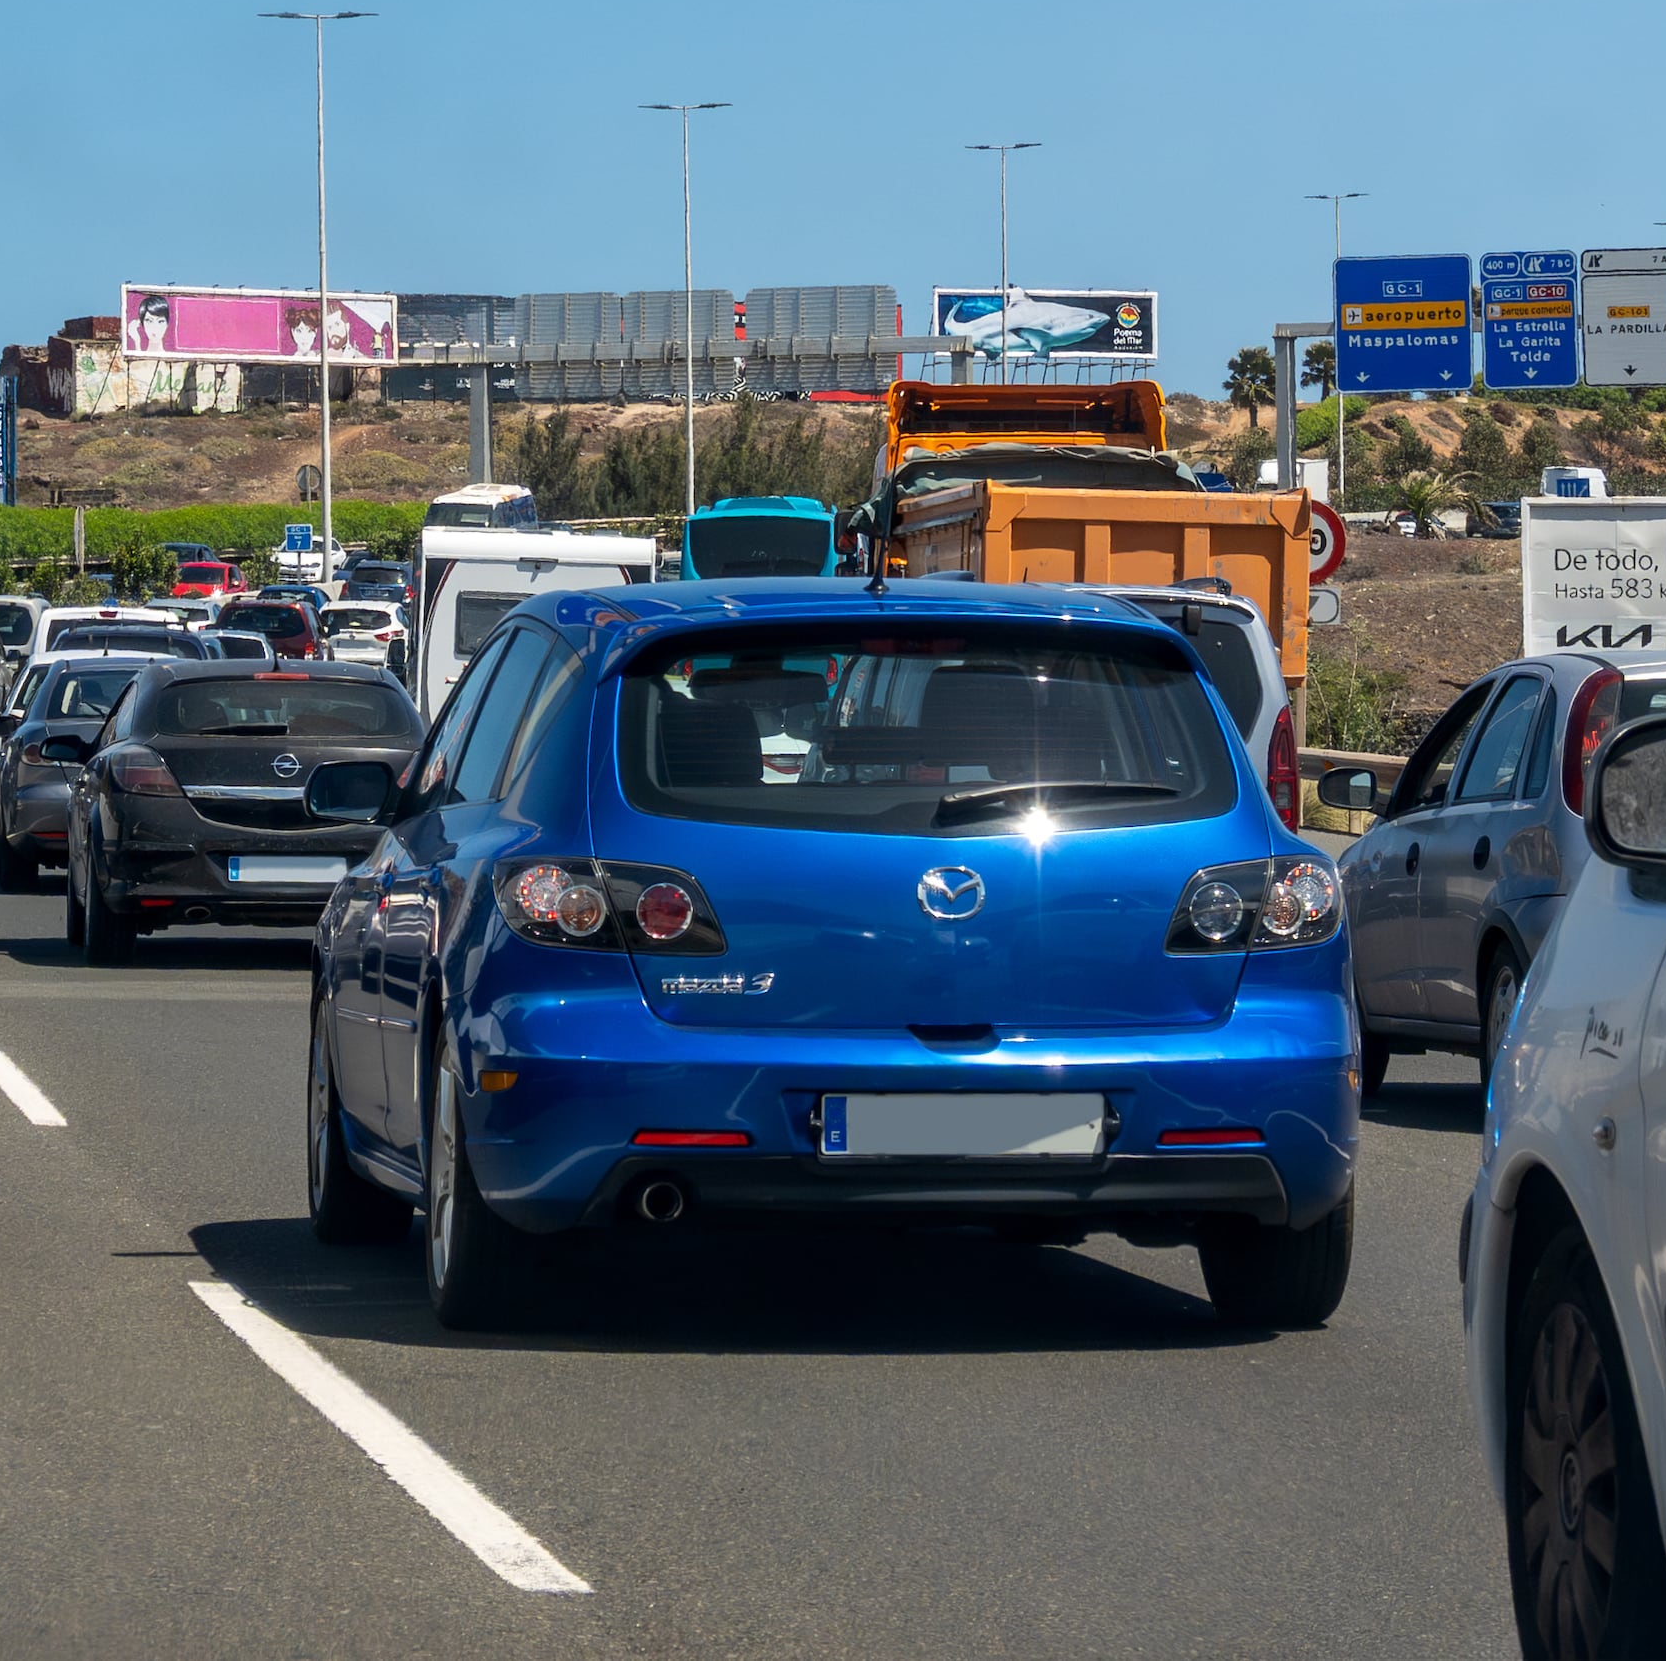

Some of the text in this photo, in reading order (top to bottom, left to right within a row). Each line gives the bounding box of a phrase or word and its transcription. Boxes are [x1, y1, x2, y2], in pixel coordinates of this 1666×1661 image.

[1486, 260, 1504, 270] 400
[1385, 283, 1421, 294] GC-1
[1494, 289, 1521, 298] GC-1
[1529, 287, 1564, 297] GC-10
[1365, 306, 1462, 323] aeropuerto
[1501, 306, 1529, 317] parque
[1493, 320, 1566, 333] La Estrella
[1587, 324, 1603, 335] LA
[1348, 334, 1459, 349] Maspalomas
[1498, 336, 1562, 348] La Garita
[1510, 350, 1551, 363] Telde
[1554, 548, 1588, 572] De
[1595, 548, 1659, 573] todo,
[1554, 582, 1605, 599] Hasta
[1610, 578, 1653, 599] 583
[830, 1130, 842, 1143] E
